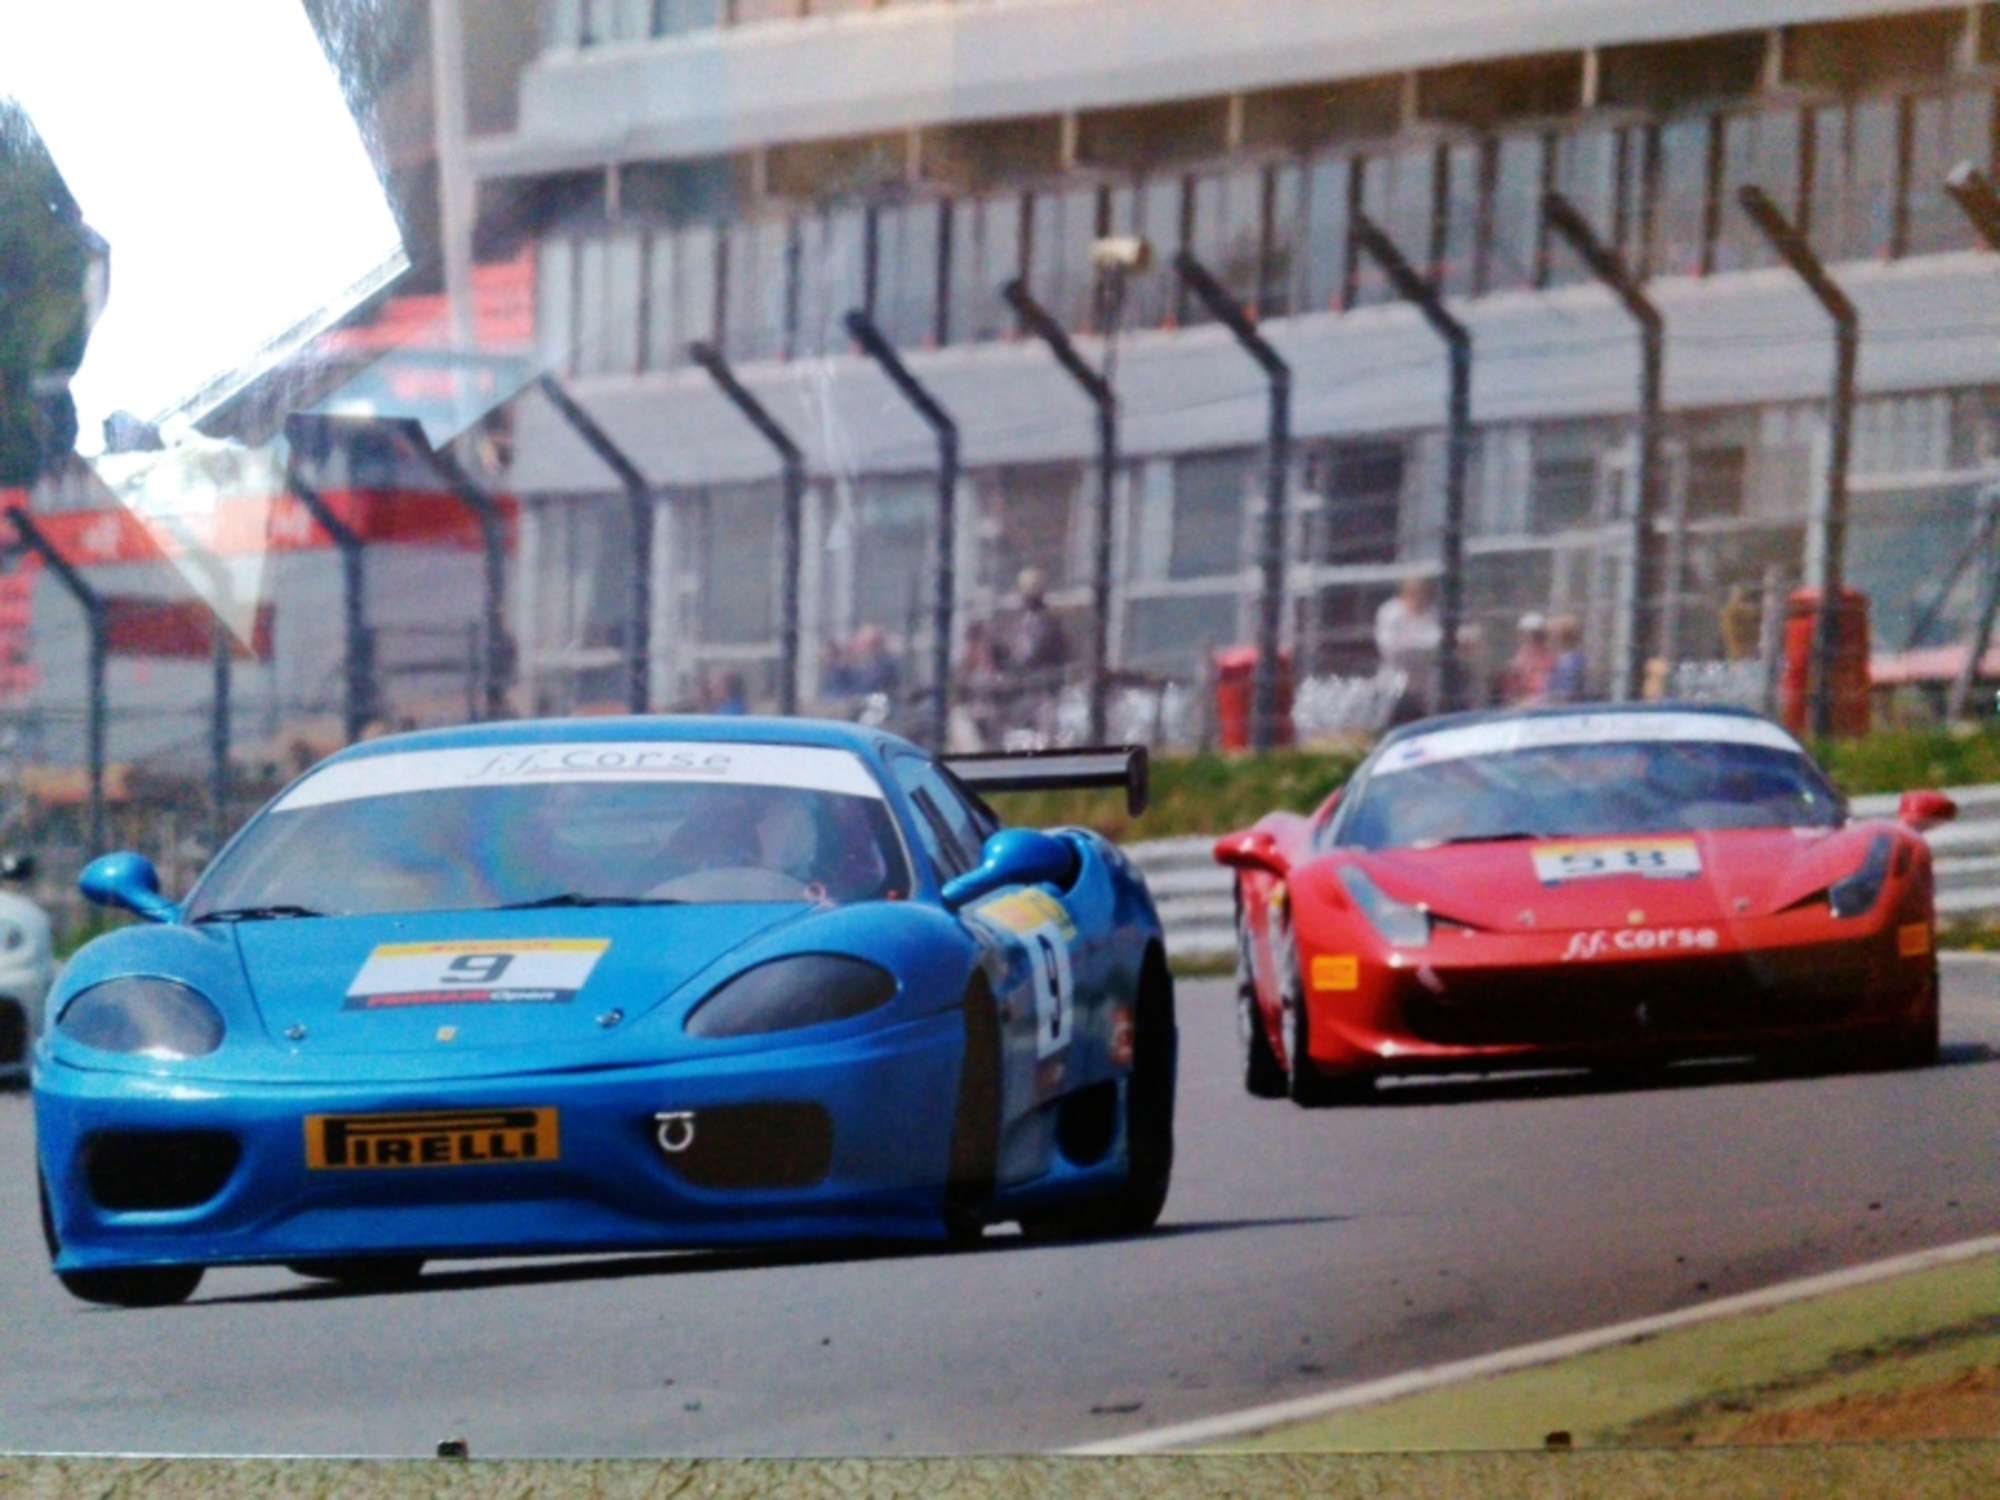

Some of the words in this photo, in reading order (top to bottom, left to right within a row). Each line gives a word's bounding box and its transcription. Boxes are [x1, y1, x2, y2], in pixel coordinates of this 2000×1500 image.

[560, 749, 732, 770] corse
[1614, 928, 1719, 950] corse
[440, 954, 516, 983] 9
[324, 1111, 537, 1166] PIRELLI
